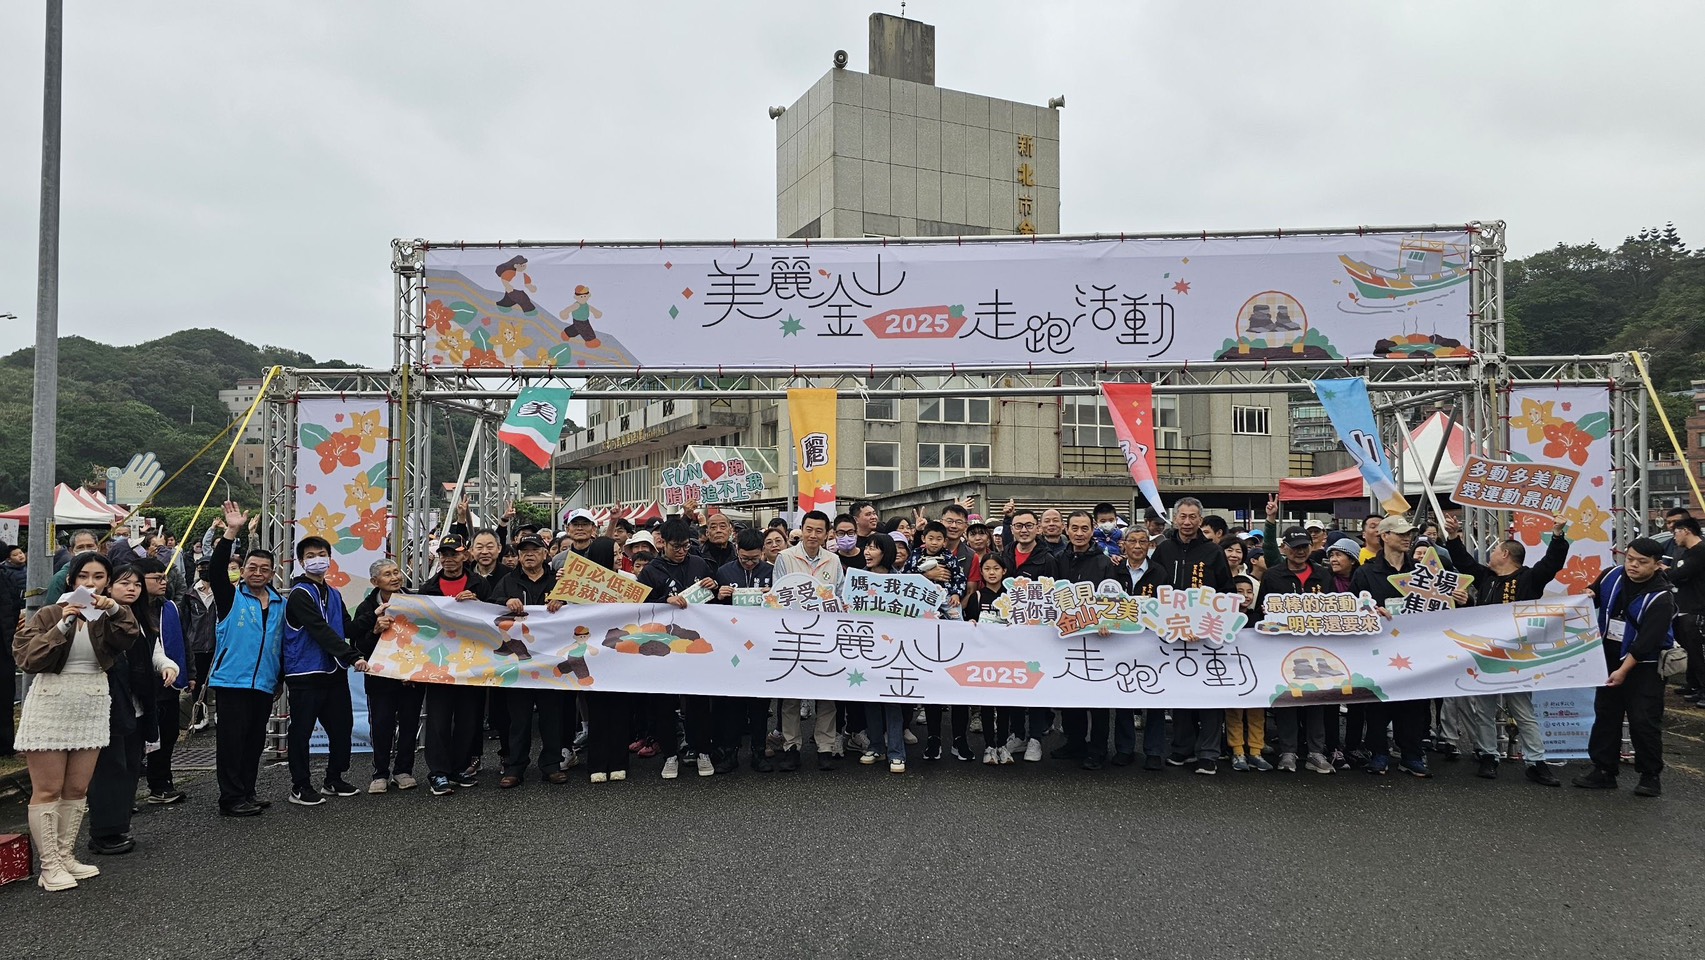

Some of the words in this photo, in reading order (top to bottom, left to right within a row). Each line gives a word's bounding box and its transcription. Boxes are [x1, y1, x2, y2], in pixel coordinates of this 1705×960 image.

[702, 253, 906, 337] 美麗金山
[885, 314, 950, 334] 2025
[959, 284, 1175, 358] 走跑活動
[663, 463, 702, 486] FUN
[727, 459, 745, 477] 跑
[1468, 461, 1573, 493] 多動多美麗
[665, 473, 763, 505] 脂肪追不上我
[1459, 481, 1563, 513] 愛運動最帥
[567, 557, 645, 603] 何必低調
[776, 581, 818, 607] 享受
[1409, 564, 1458, 596] 全場
[852, 595, 920, 618] 新北金山
[1053, 583, 1096, 612] 看見
[1146, 588, 1242, 617] PERFECT
[1267, 595, 1357, 613] 最棒的活動
[1287, 614, 1380, 632] 明年還要來
[766, 614, 964, 698] 美麗金山
[966, 665, 1028, 685] 2025
[1052, 636, 1258, 697] 走跑活動
